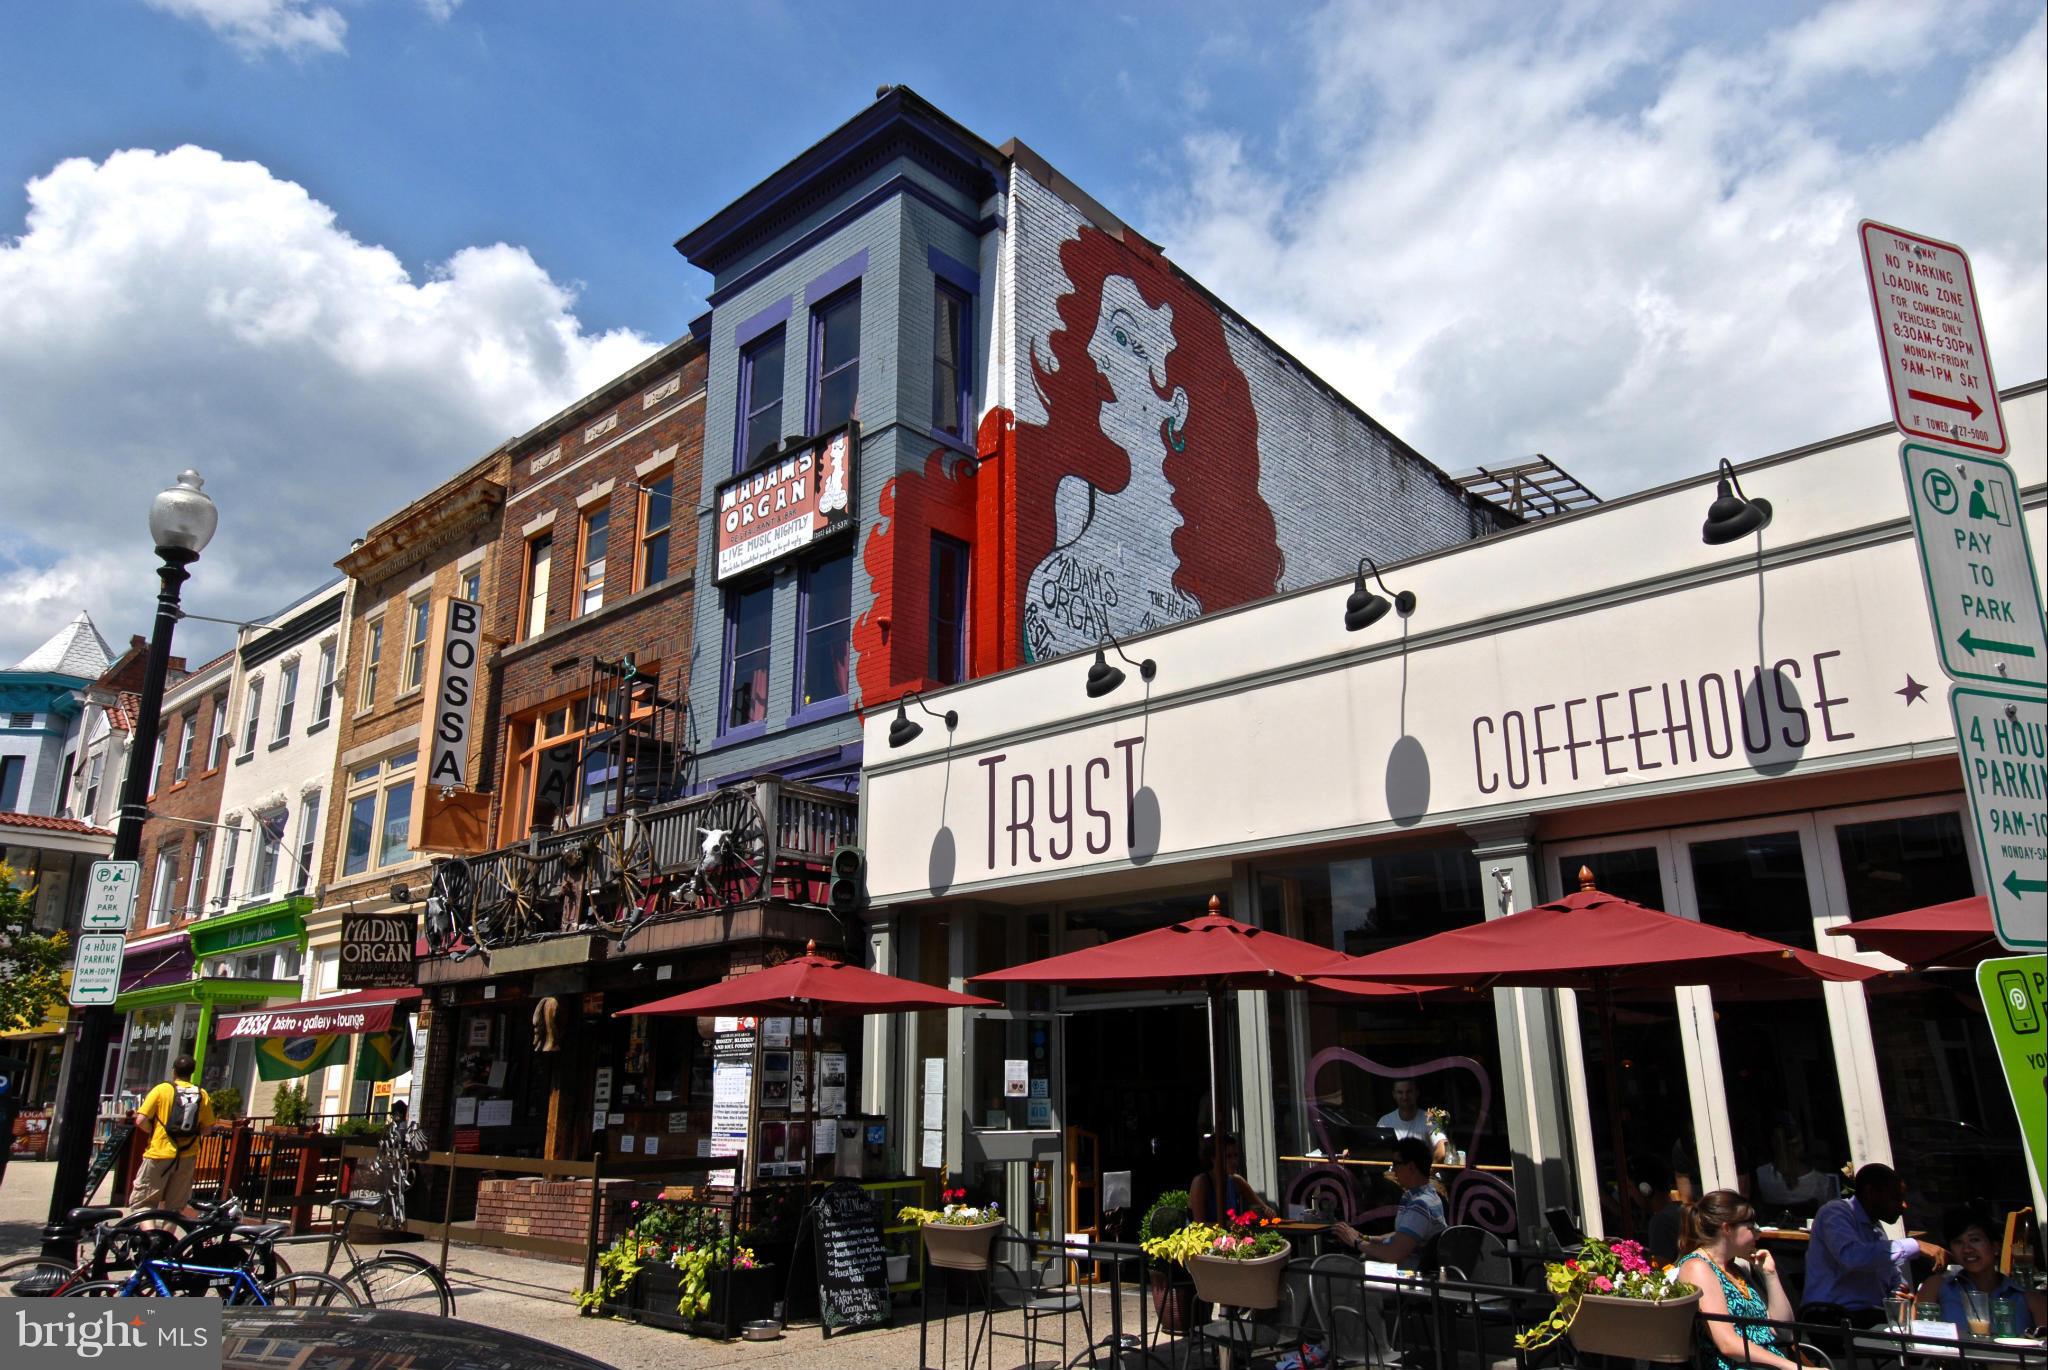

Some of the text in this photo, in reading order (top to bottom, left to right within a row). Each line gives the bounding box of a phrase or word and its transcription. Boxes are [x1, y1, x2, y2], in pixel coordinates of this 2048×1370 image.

[1894, 240, 1937, 261] TOW WAY
[1885, 253, 1954, 284] NO PARKING
[1882, 272, 1964, 307] LOADING ZONE
[1891, 294, 1964, 323] FOR COMMERCIAL
[1897, 311, 1962, 337] VEHICLES ONLY
[1903, 343, 1969, 370] MONDAY-FRIDAY
[1901, 358, 1979, 390] 9AM-1PM SAT
[1913, 415, 1990, 442] IF TOWED 27-5000
[725, 476, 807, 533] ORGAN
[722, 515, 810, 565] LIVE MUSIC NIGHTLY
[1954, 528, 1992, 555] PAY
[1968, 562, 1995, 587] TO
[1042, 579, 1110, 640] ORGAN
[1147, 590, 1166, 609] THE
[1961, 594, 2016, 624] PARK
[432, 602, 476, 782] BOSSA
[1969, 715, 1985, 752] 4
[978, 649, 1855, 870] TRYST COFFEEHOUSE
[97, 903, 118, 911] PARK
[105, 894, 115, 902] TO
[84, 955, 115, 964] PARKING
[85, 942, 117, 952] 4 HOUR
[342, 943, 411, 962] ORGAN
[79, 967, 116, 976] 9AM-10PM
[231, 1012, 364, 1036] BOSSA bistro gallery lounge
[2026, 1053, 2047, 1070] YO
